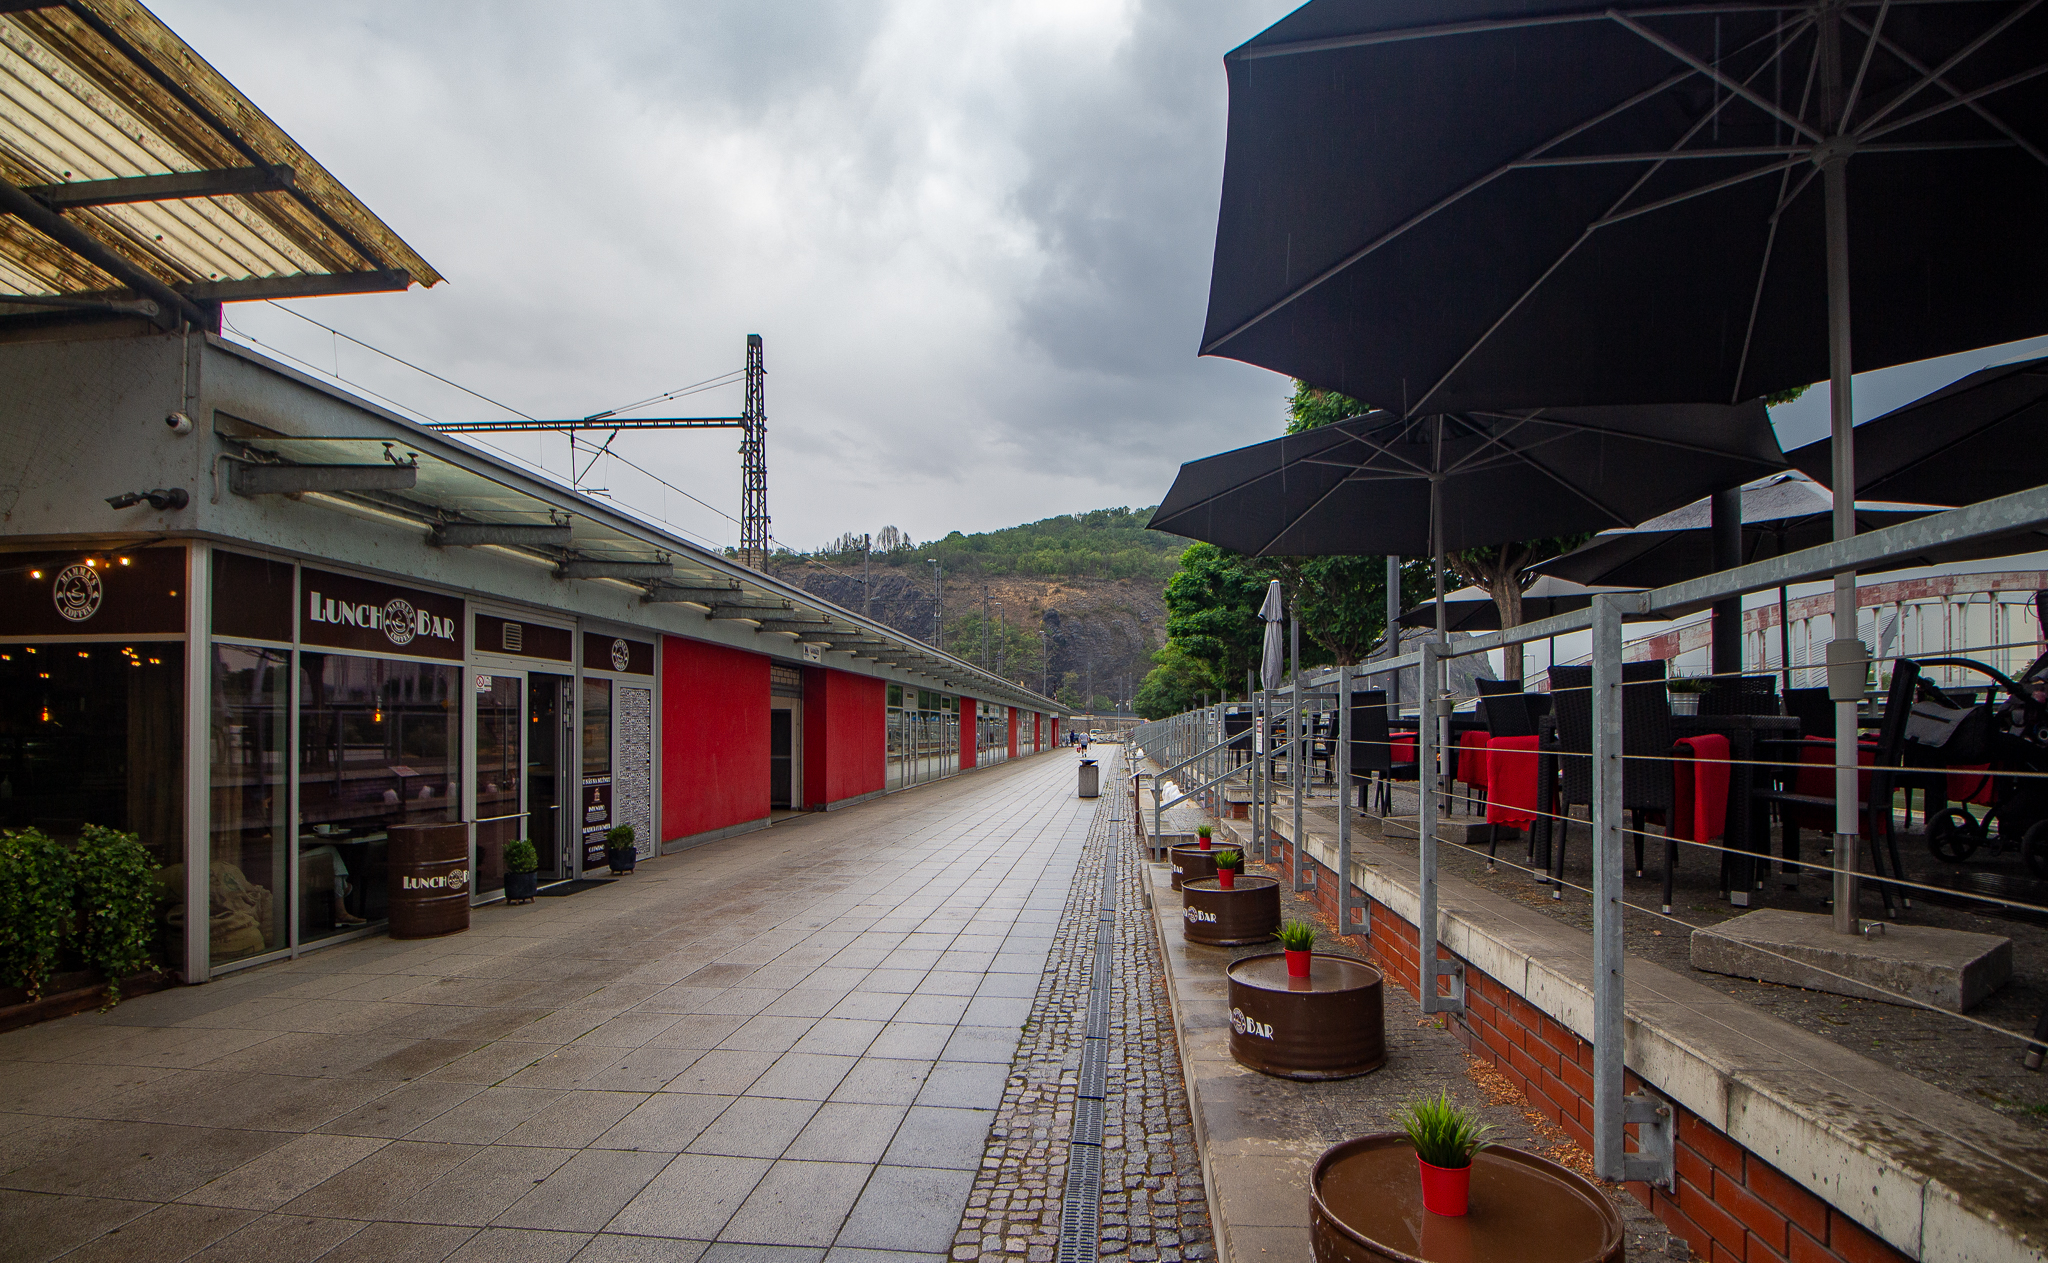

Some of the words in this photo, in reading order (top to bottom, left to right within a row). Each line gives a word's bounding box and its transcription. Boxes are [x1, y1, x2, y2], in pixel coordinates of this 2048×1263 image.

[60, 566, 98, 584] MAMMA'S
[63, 603, 94, 619] COFFEE
[310, 590, 383, 630] LUNCH
[416, 608, 455, 642] BAR
[387, 601, 413, 618] MAMMA'S
[390, 632, 412, 643] COFFEE
[1173, 864, 1184, 875] BAR
[403, 875, 447, 890] LUNCH
[1197, 910, 1217, 924] BAR
[1246, 1016, 1274, 1041] BAR
